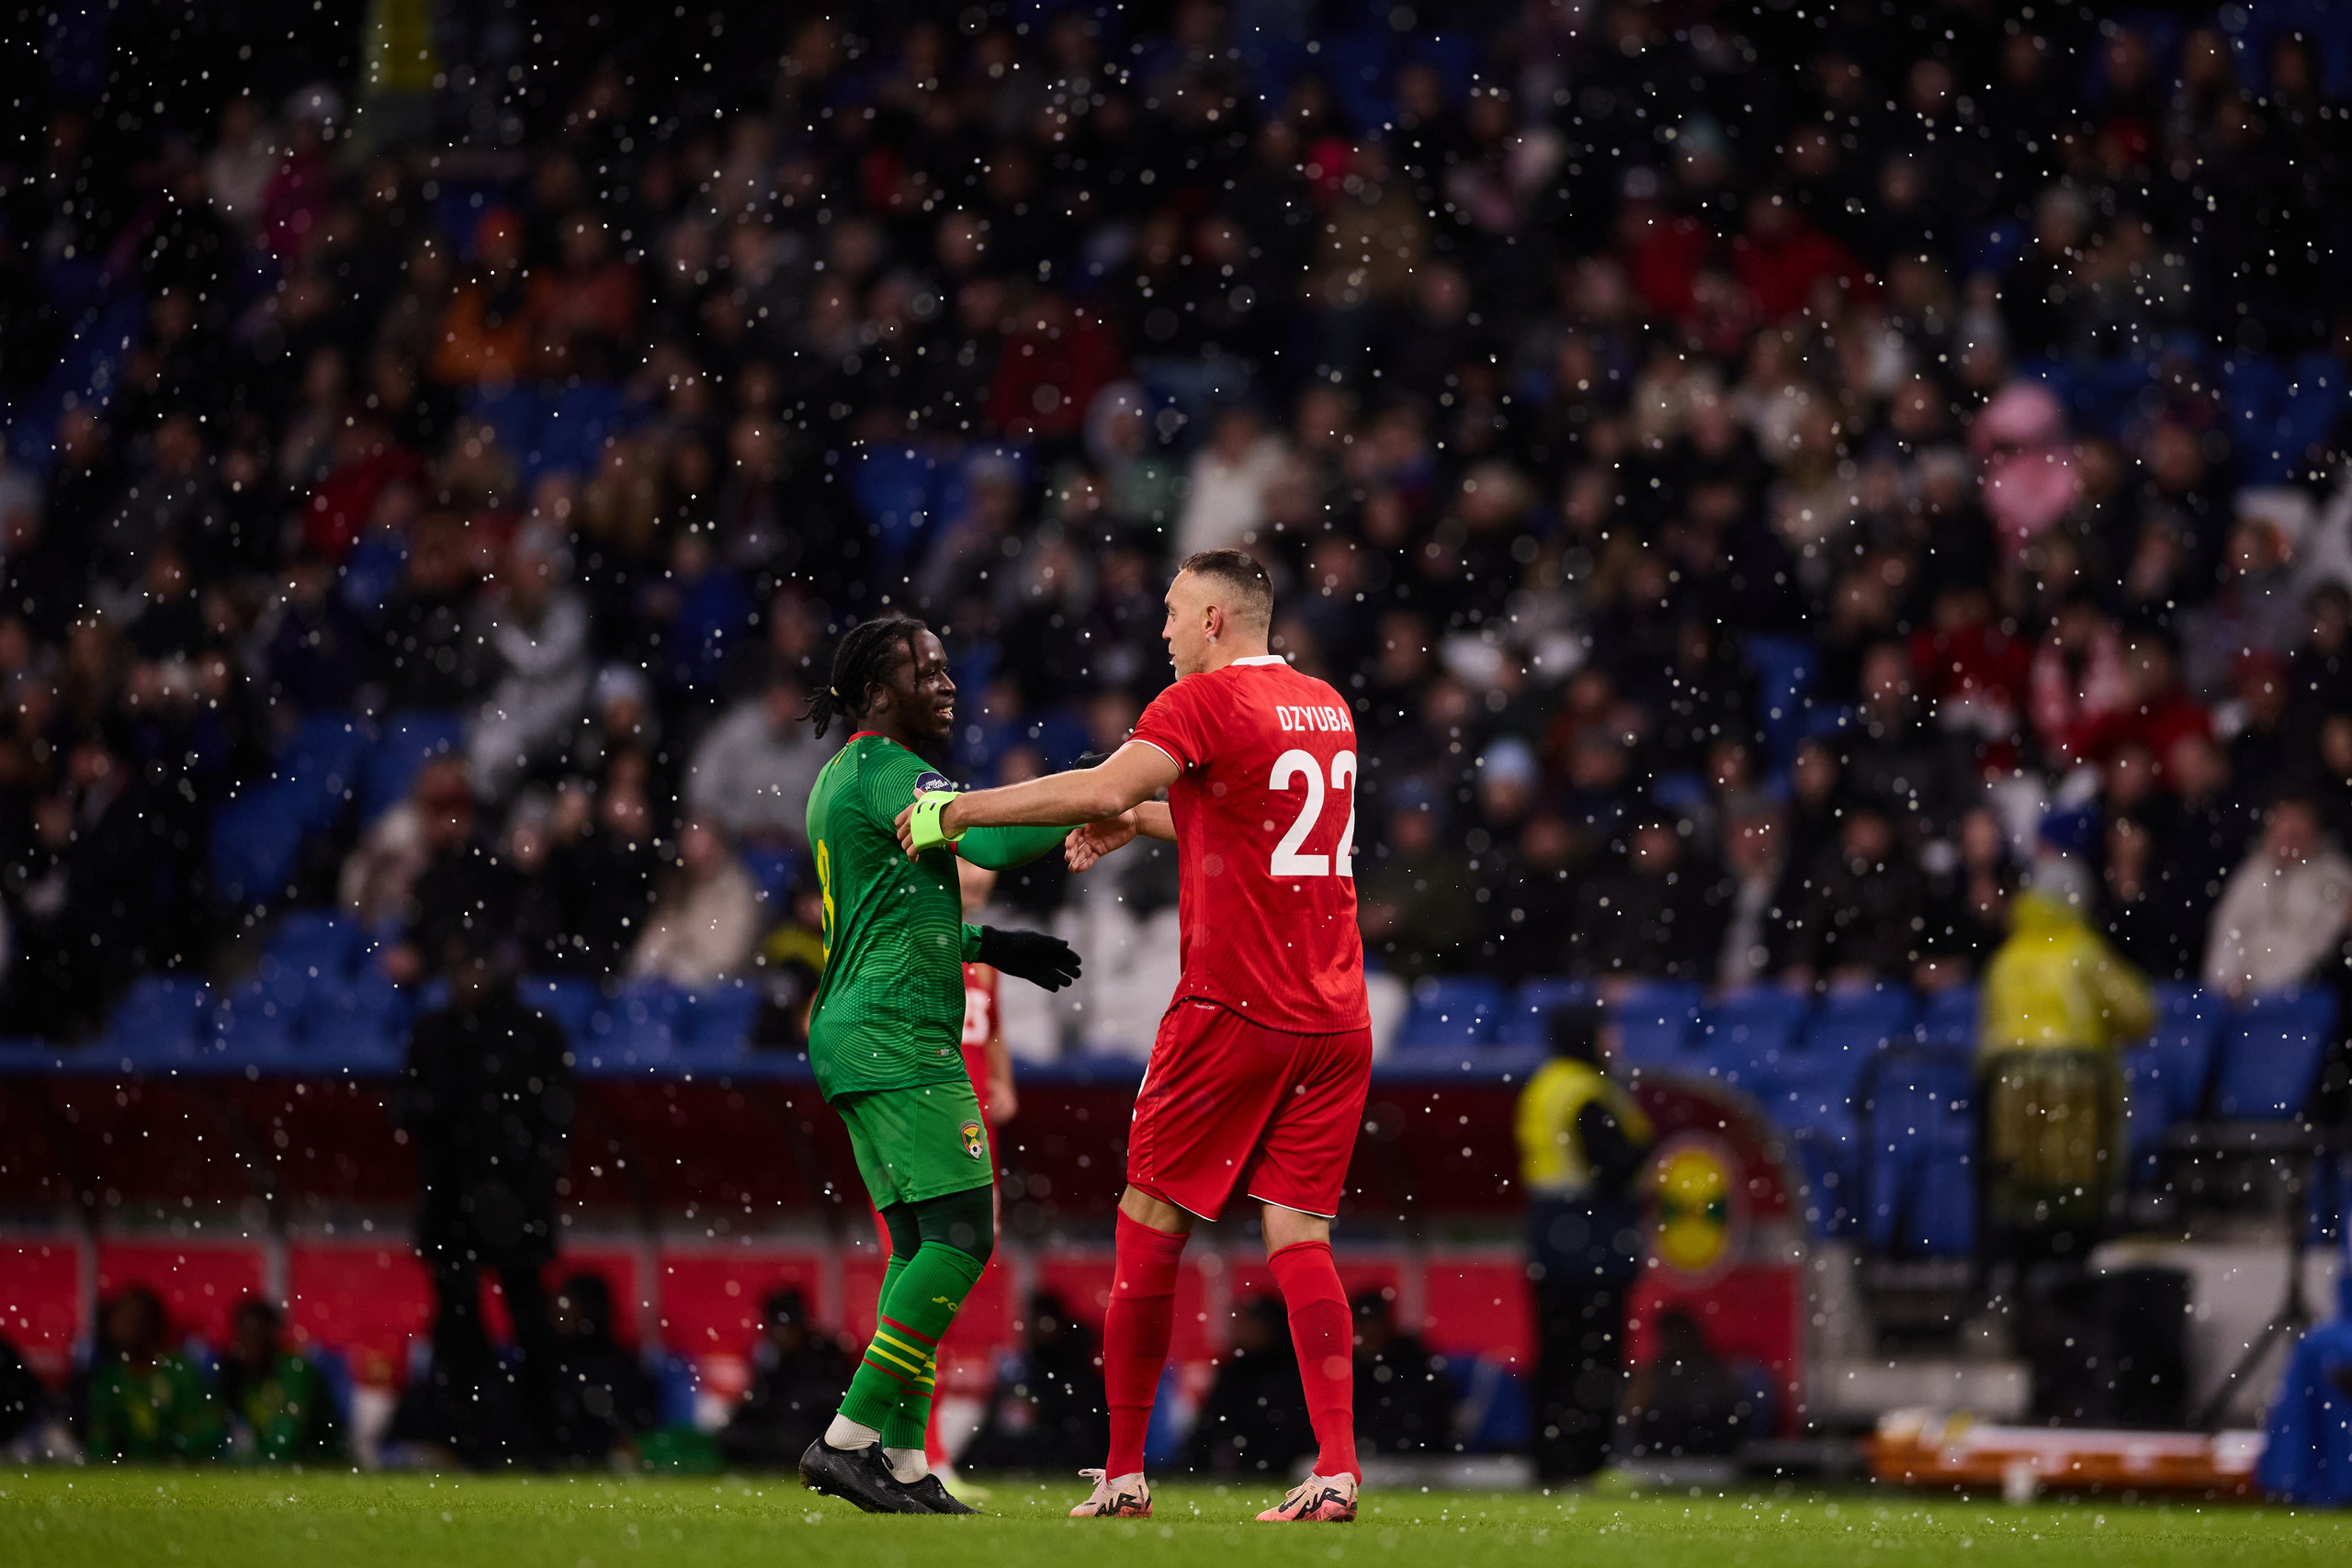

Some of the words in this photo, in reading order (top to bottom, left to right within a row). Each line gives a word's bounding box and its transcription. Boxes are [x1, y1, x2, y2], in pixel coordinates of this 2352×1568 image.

[1276, 705, 1352, 732] DZYUBA
[1269, 749, 1357, 877] 22
[1292, 1487, 1348, 1521] AIR
